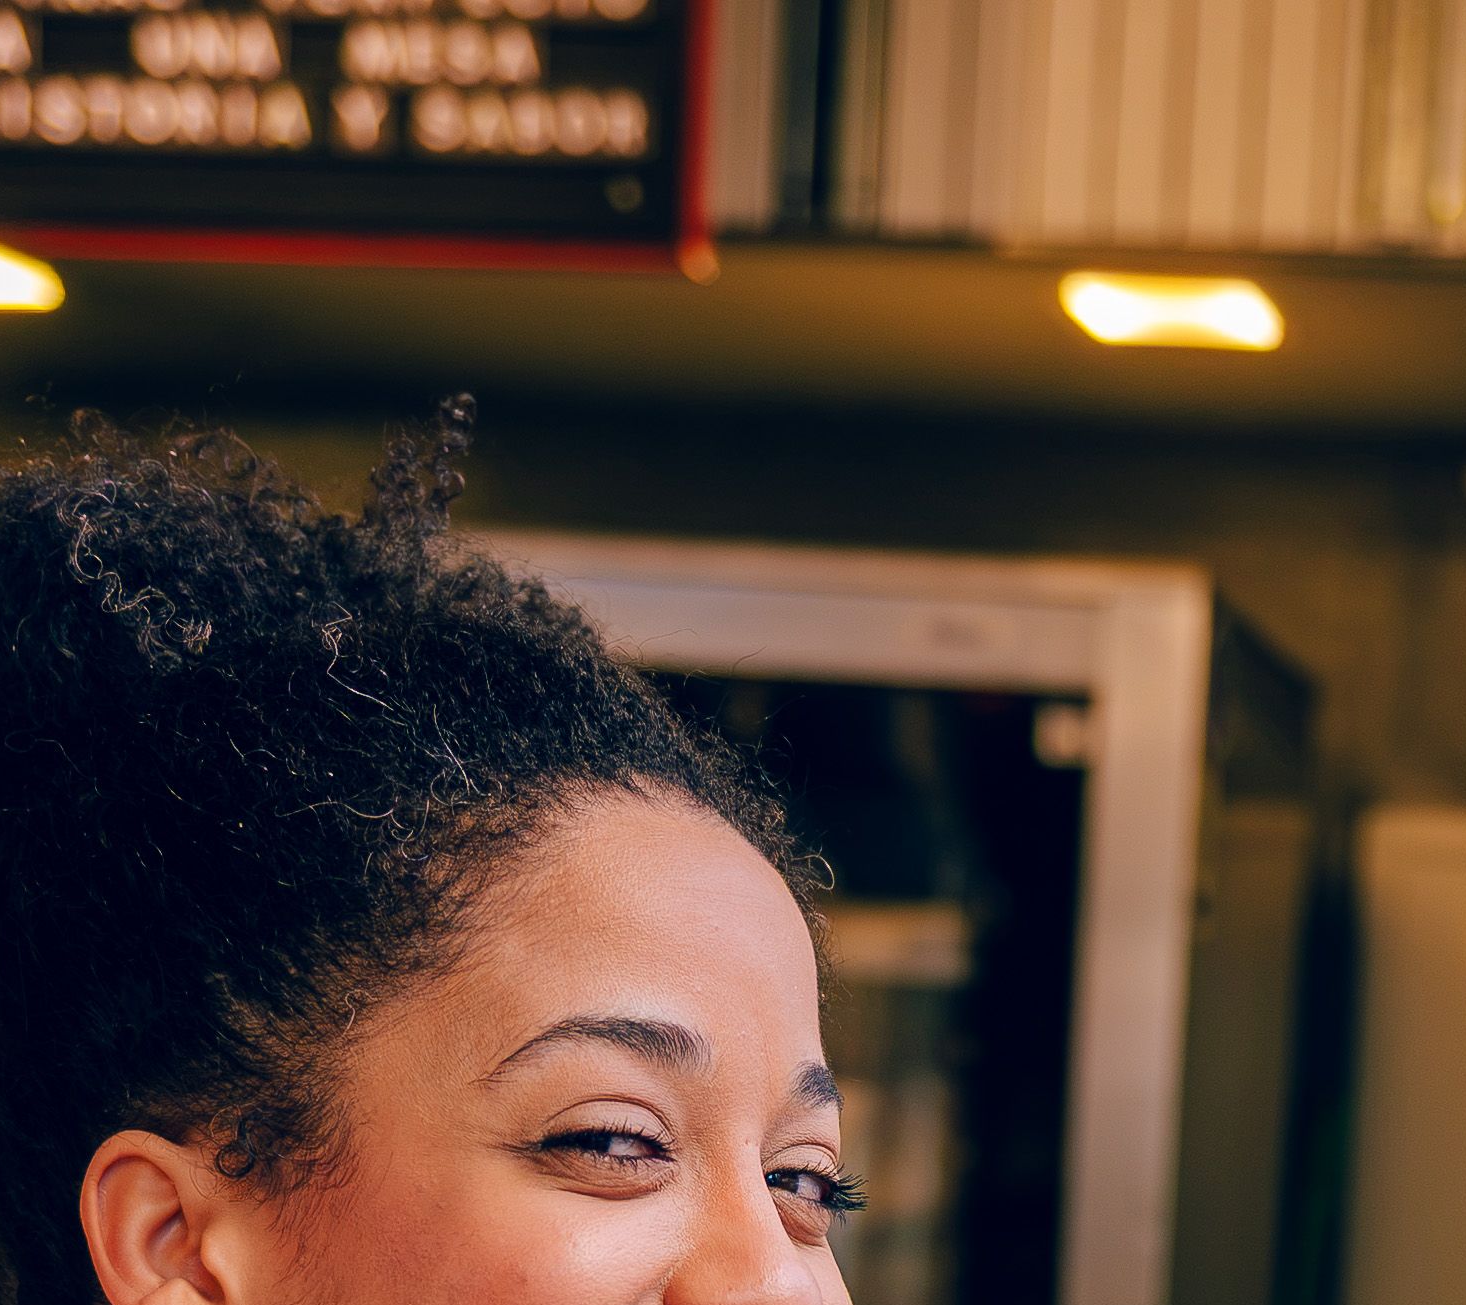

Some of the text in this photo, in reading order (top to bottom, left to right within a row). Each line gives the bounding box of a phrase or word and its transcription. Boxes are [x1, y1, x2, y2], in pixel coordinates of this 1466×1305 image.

[135, 11, 281, 80] UNA
[345, 18, 541, 85] MESA
[336, 83, 387, 152] Y
[415, 85, 648, 156] SABOR
